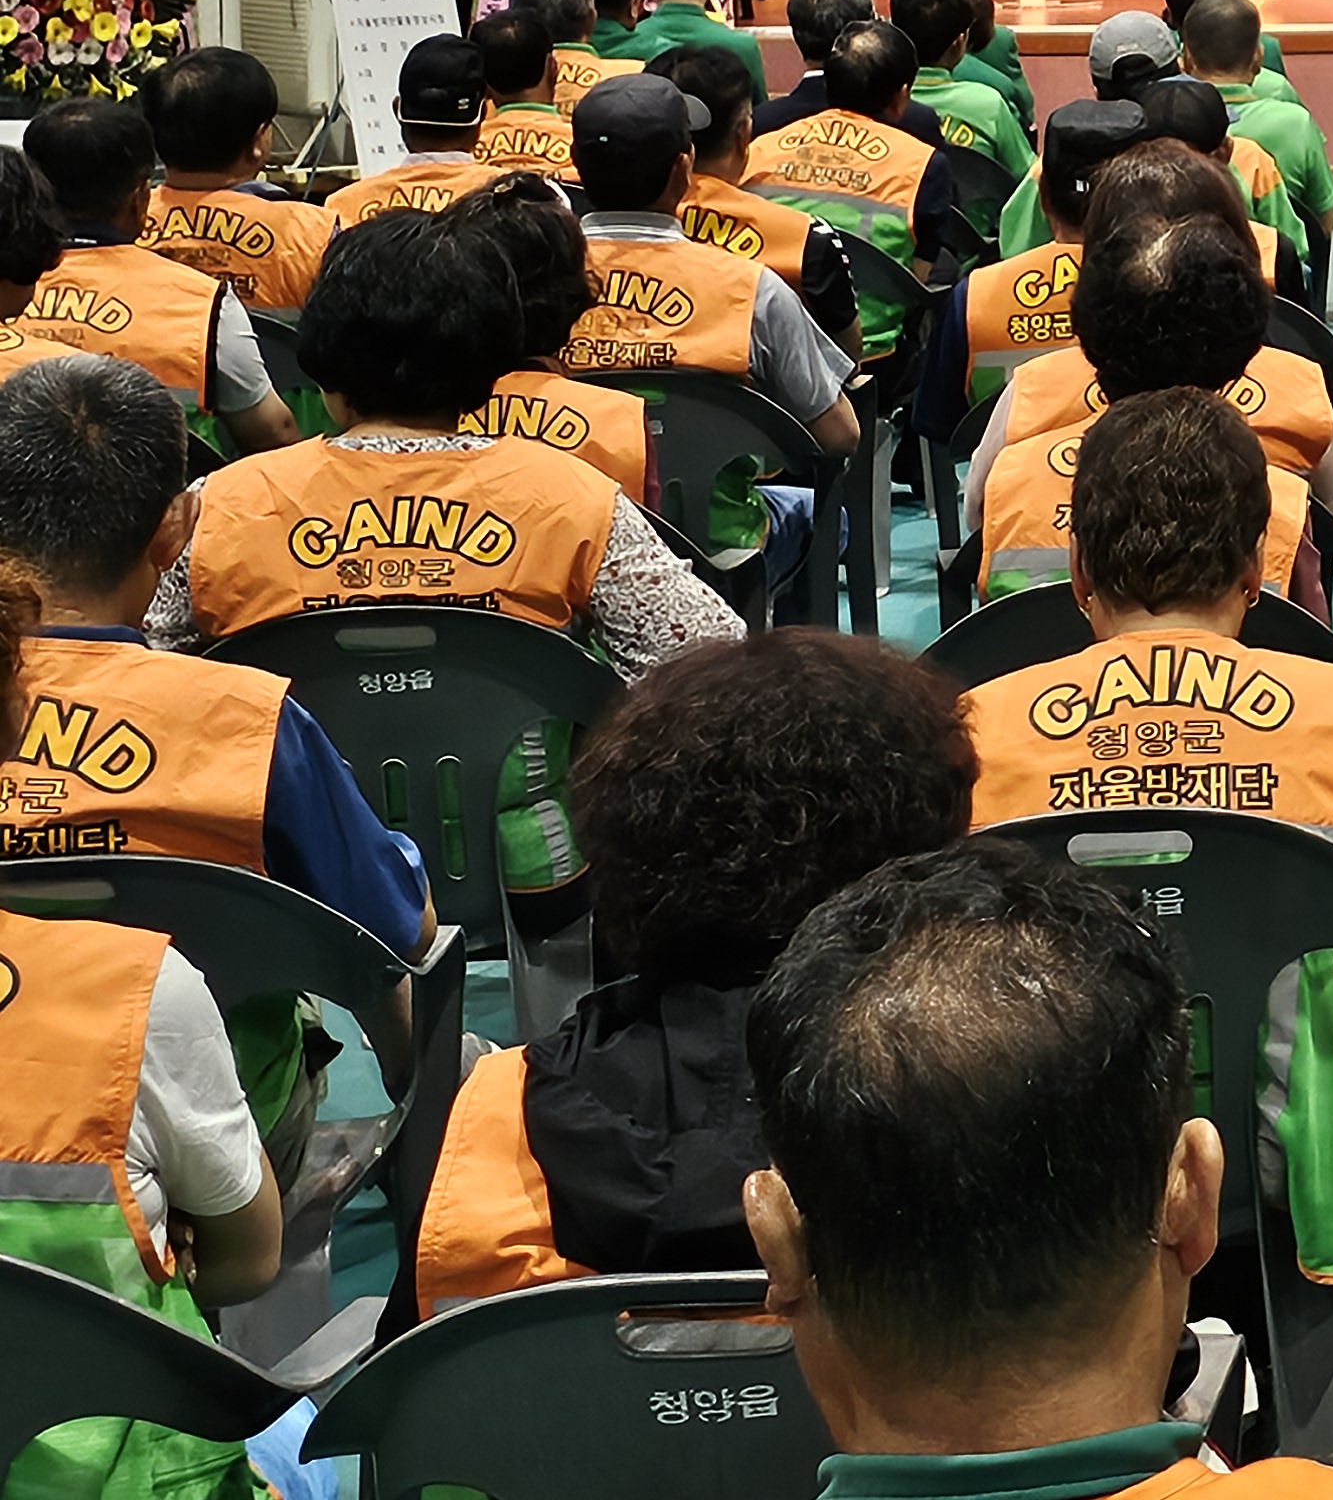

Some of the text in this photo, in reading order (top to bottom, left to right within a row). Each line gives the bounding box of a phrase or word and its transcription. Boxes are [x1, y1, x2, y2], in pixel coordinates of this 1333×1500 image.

[778, 120, 890, 162] CAIND
[360, 185, 453, 222] CAIN
[682, 204, 764, 260] IND
[5, 284, 132, 333] IND
[1007, 311, 1075, 344] 청양군
[558, 338, 677, 369] 율방재단
[288, 495, 517, 569] CAIND
[336, 557, 456, 589] 청양군
[358, 668, 435, 695] 청양읍
[1027, 644, 1296, 741] CAIND
[1087, 719, 1226, 761] 청양군
[1048, 762, 1280, 811] 자율방재단
[648, 1383, 783, 1427] 청양읍
